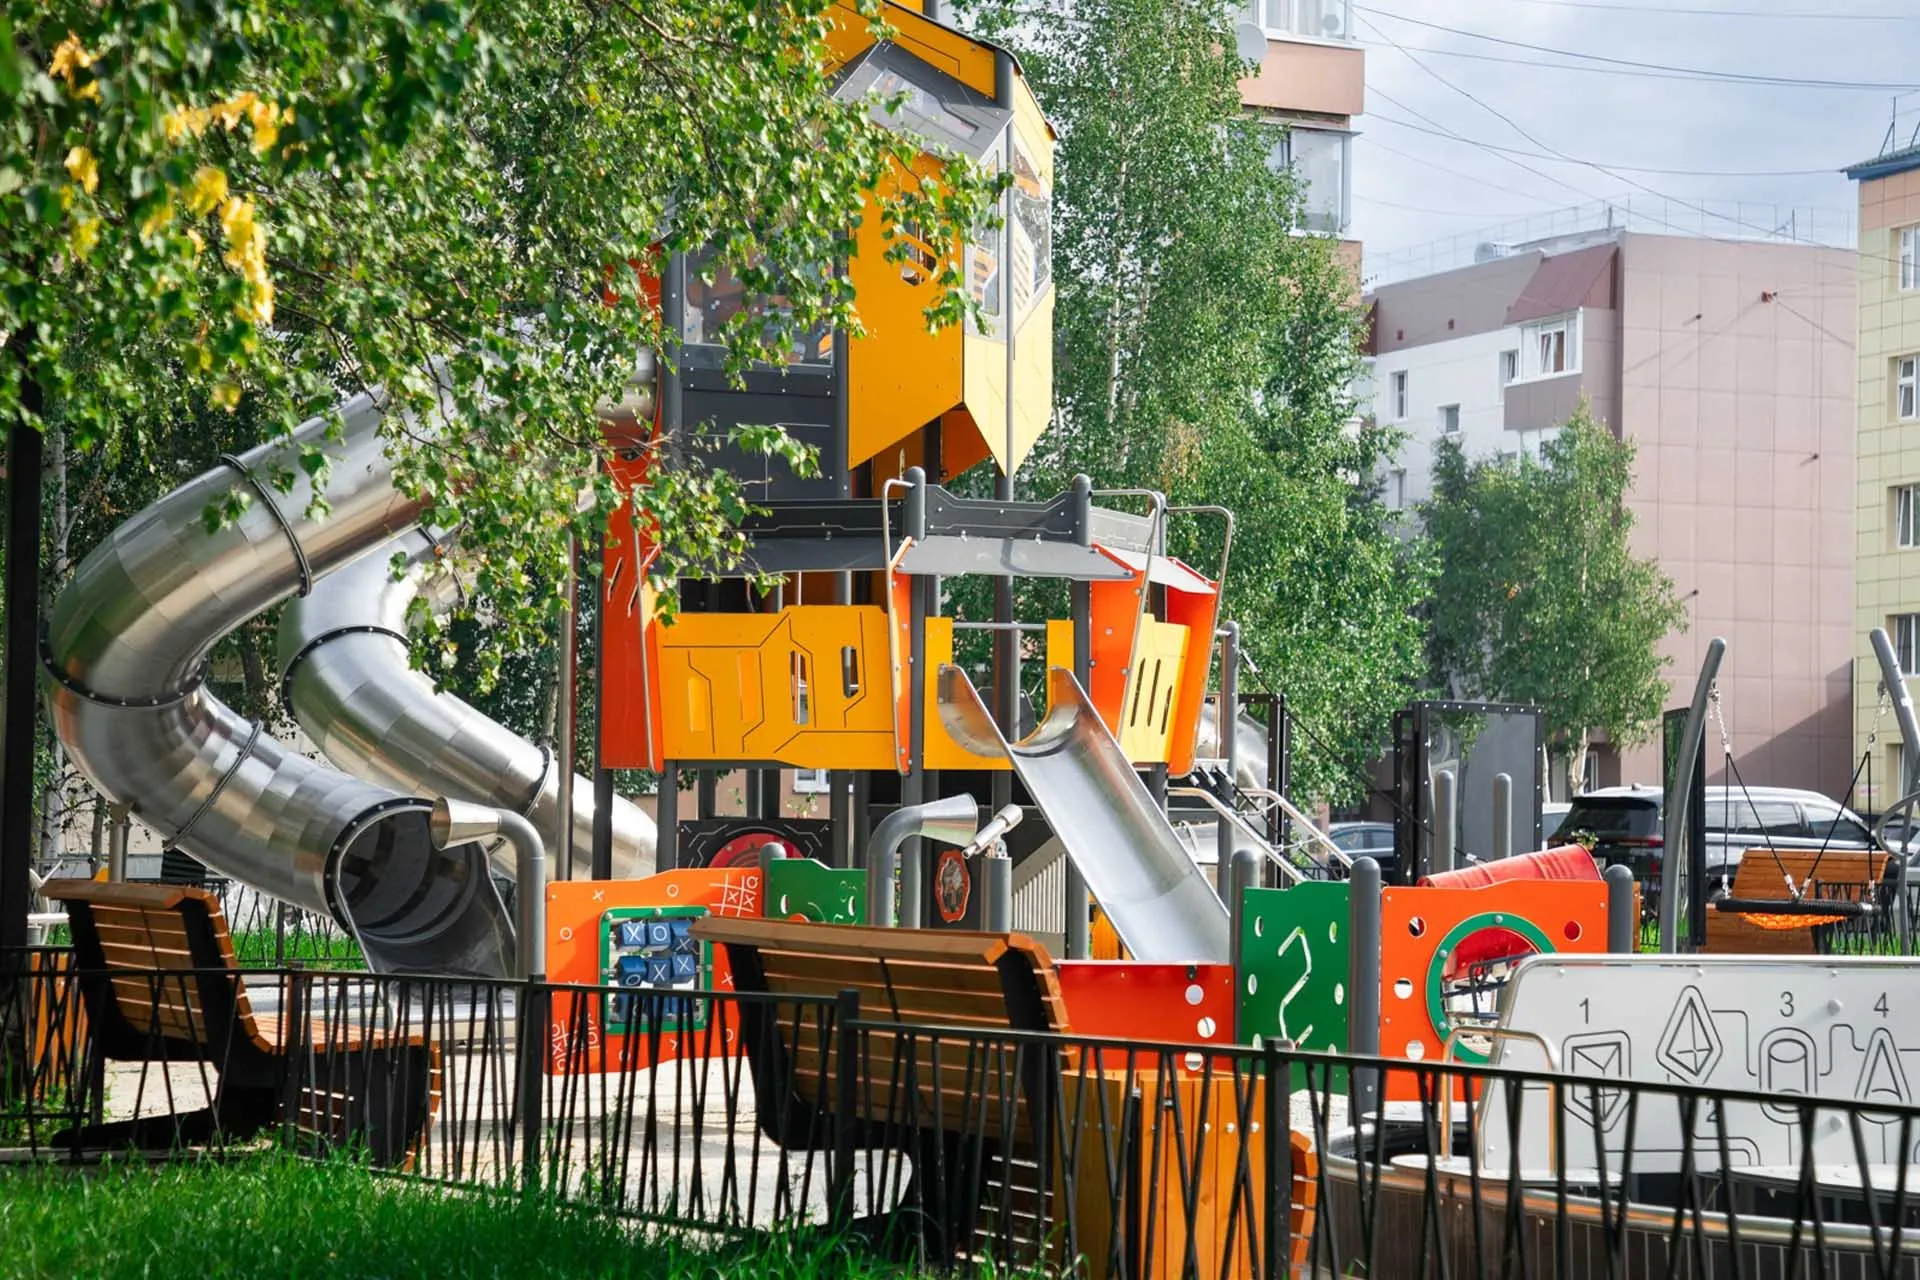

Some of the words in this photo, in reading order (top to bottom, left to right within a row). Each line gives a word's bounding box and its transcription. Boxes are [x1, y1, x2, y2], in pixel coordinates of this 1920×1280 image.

[624, 924, 641, 943] X
[652, 924, 668, 942] O
[1578, 998, 1590, 1024] 1
[1779, 991, 1795, 1018] 3
[1873, 992, 1890, 1018] 4
